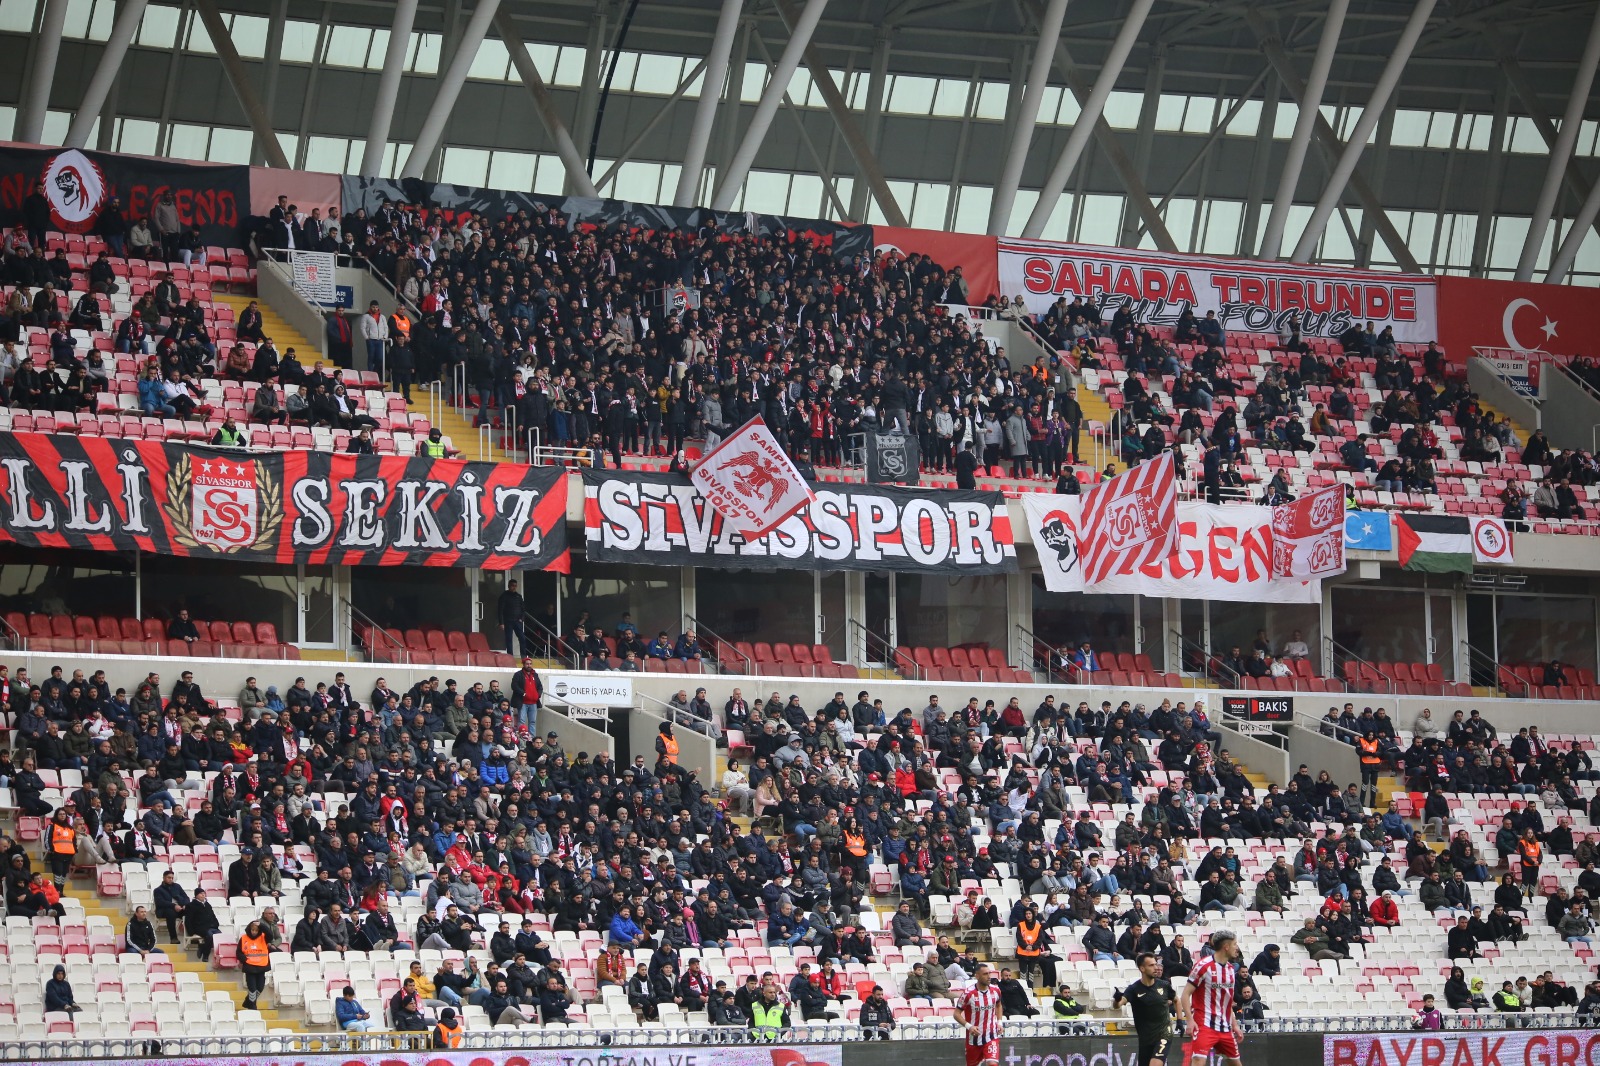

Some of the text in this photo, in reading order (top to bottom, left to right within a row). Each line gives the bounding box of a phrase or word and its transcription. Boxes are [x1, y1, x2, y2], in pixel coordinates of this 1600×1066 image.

[108, 184, 238, 229] EGEND
[335, 290, 346, 298] ARI
[1024, 257, 1417, 322] SAHADA TRIBUNDE
[195, 474, 253, 488] SİVASSPOR
[698, 468, 764, 528] SİVASSPOR
[293, 472, 542, 554] SEKİZ
[1136, 492, 1152, 537] SİVASSPOR
[195, 529, 213, 538] 1967
[591, 685, 598, 698] İŞ
[599, 687, 615, 696] YAPI
[570, 707, 588, 716] ÇKIŞ
[1258, 701, 1288, 712] BAKIŞ
[1240, 723, 1256, 732] ÇIKŞ
[1333, 1036, 1506, 1066] BAYRAK
